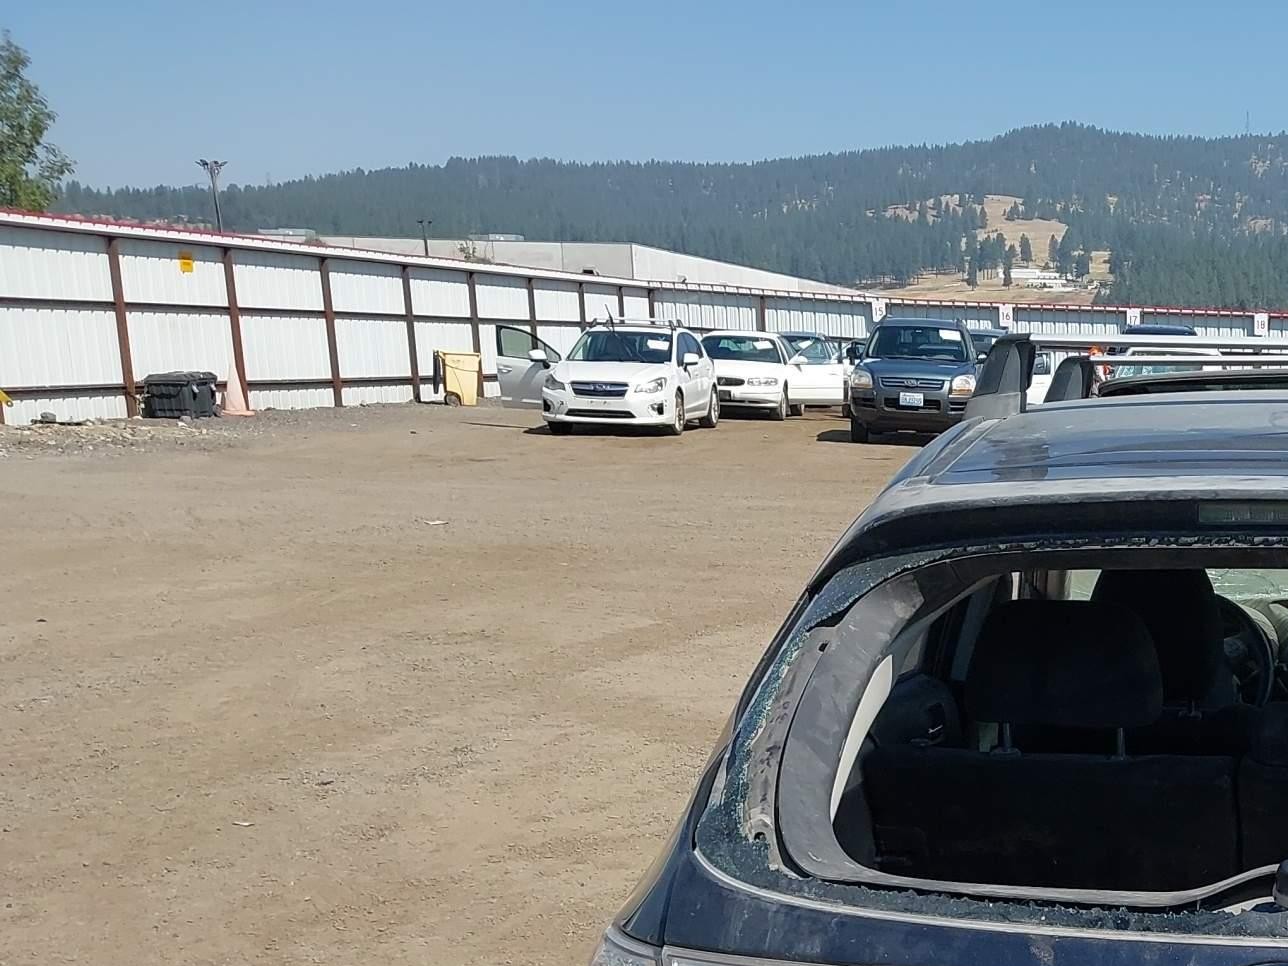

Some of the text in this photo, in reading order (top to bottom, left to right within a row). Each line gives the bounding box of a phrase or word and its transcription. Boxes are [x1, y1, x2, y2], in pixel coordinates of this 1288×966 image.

[874, 306, 884, 316] 15
[1001, 310, 1011, 321] 16
[1129, 315, 1138, 325] 17
[1256, 319, 1266, 330] 18
